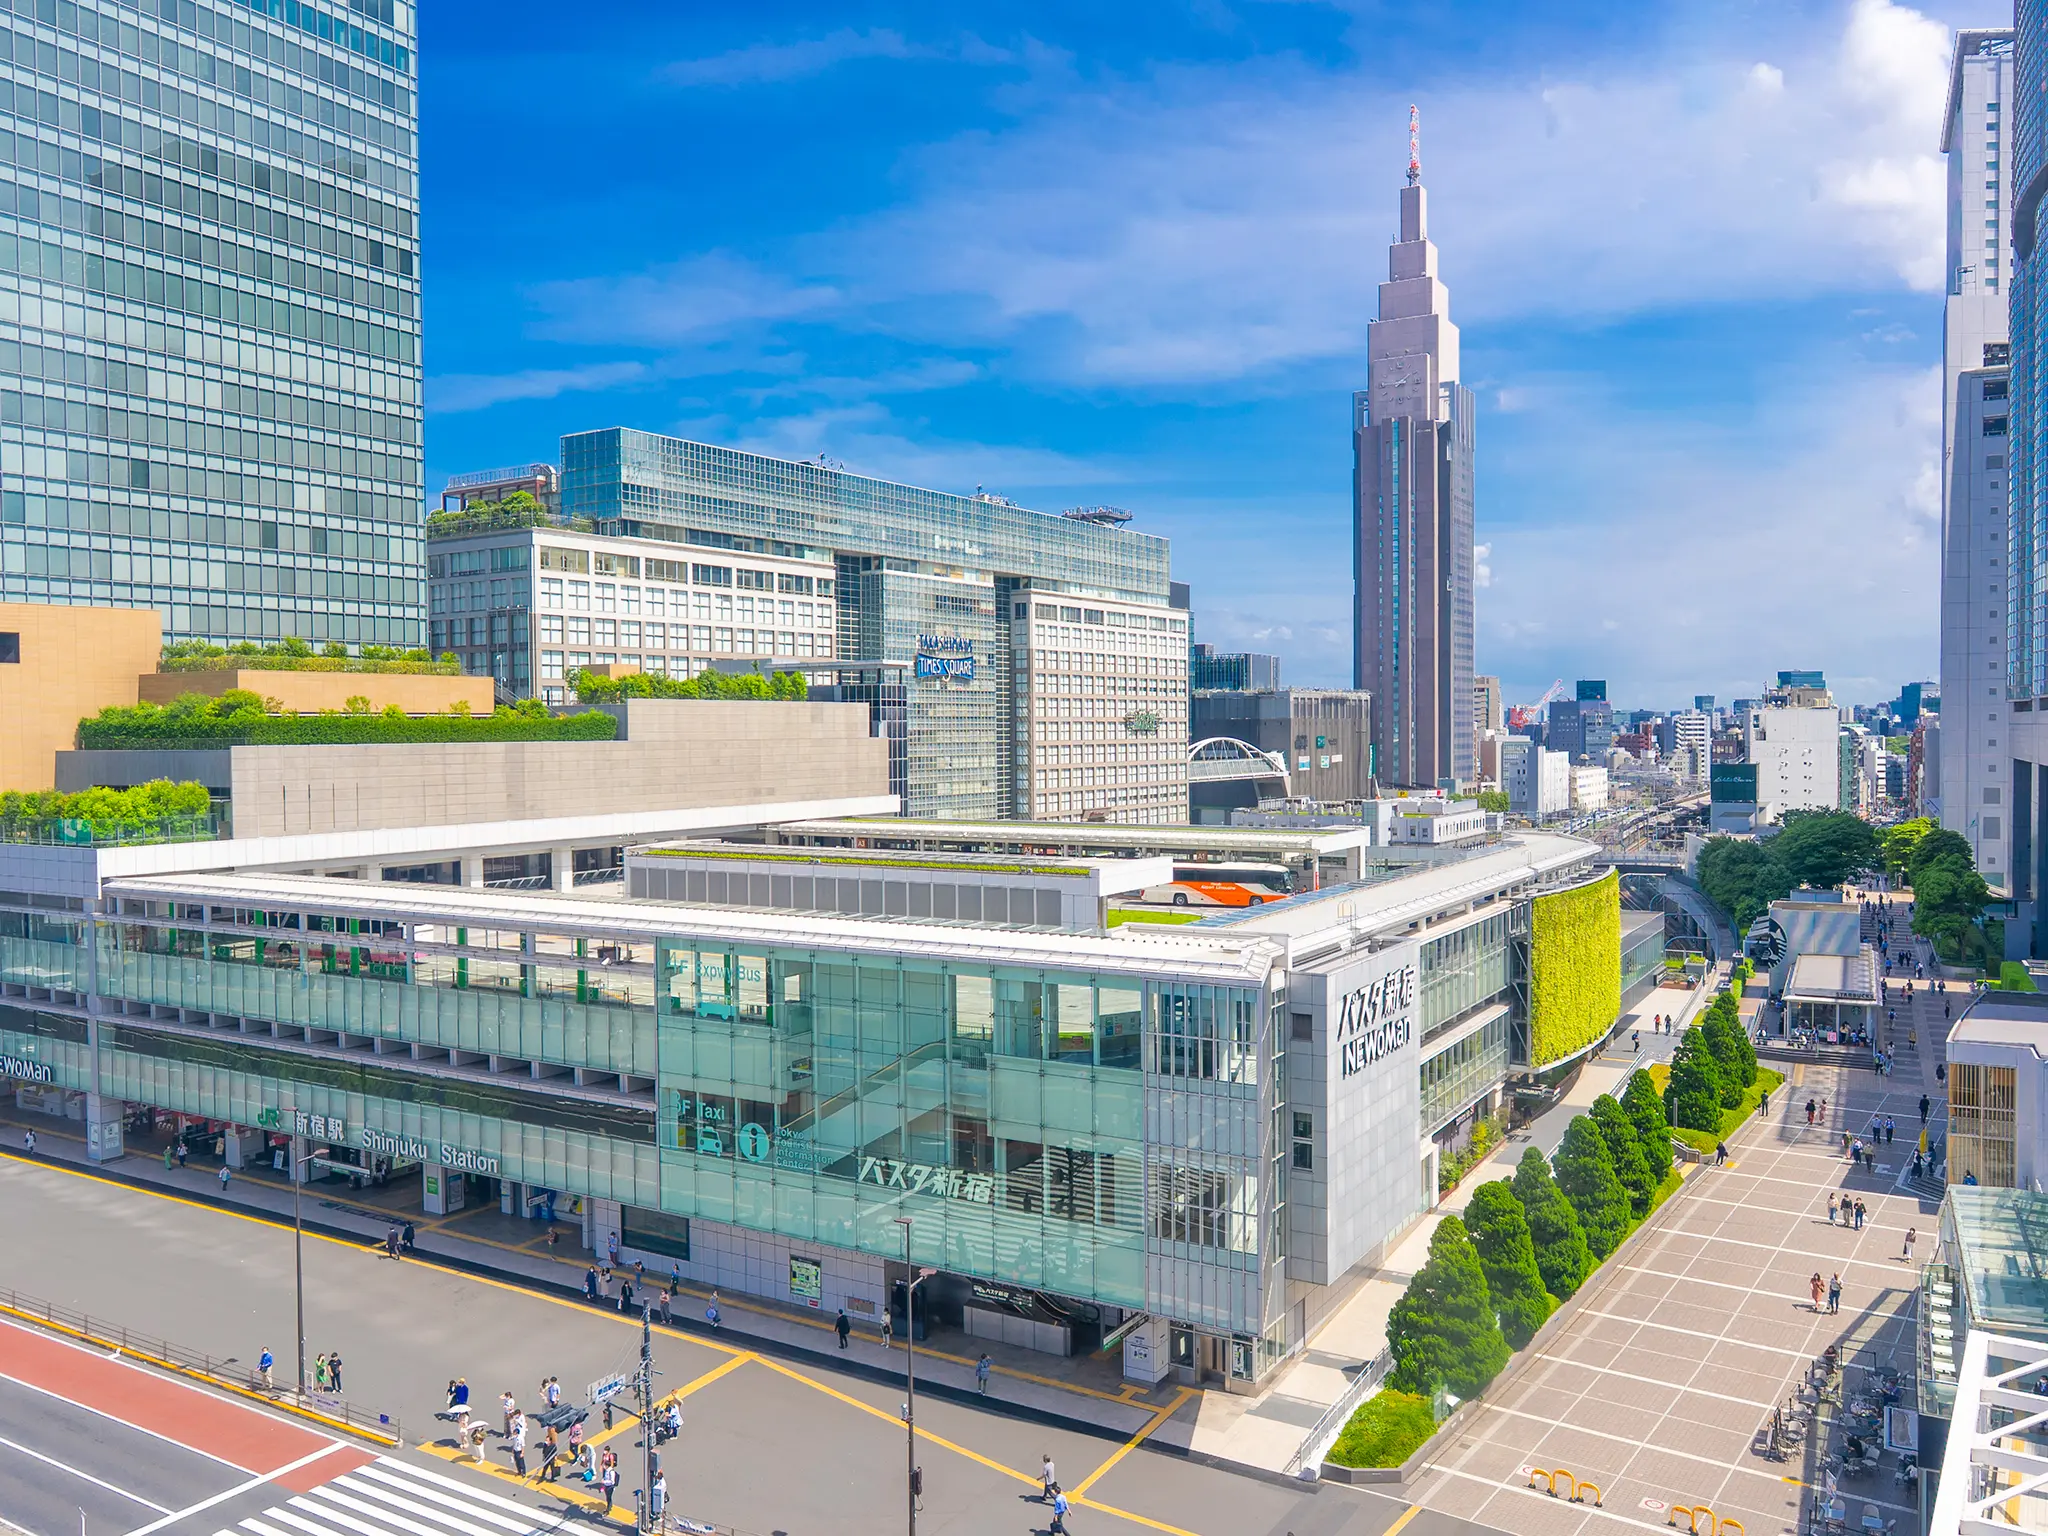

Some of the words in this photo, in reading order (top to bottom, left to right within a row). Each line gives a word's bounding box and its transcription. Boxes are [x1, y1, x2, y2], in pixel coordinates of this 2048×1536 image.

[917, 634, 973, 652] TAKASHIMAYA
[919, 657, 942, 674] TIMES
[943, 659, 972, 682] SQUARE
[666, 951, 689, 974] 4F
[696, 960, 732, 984] Expwy
[736, 964, 761, 983] Bus
[1337, 964, 1416, 1041] バスタ新宿
[1835, 991, 1875, 999] STARBUCKS
[1342, 1016, 1412, 1078] NEWoMan
[257, 1107, 281, 1129] JR
[698, 1101, 725, 1121] Taxi
[296, 1112, 345, 1142] 新宿駅
[775, 1126, 805, 1140] Tokyo
[362, 1128, 428, 1160] Shinjuku
[440, 1144, 499, 1174] Station
[776, 1147, 834, 1166] Information
[775, 1157, 809, 1171] Center
[857, 1155, 995, 1204] バスタ新宿
